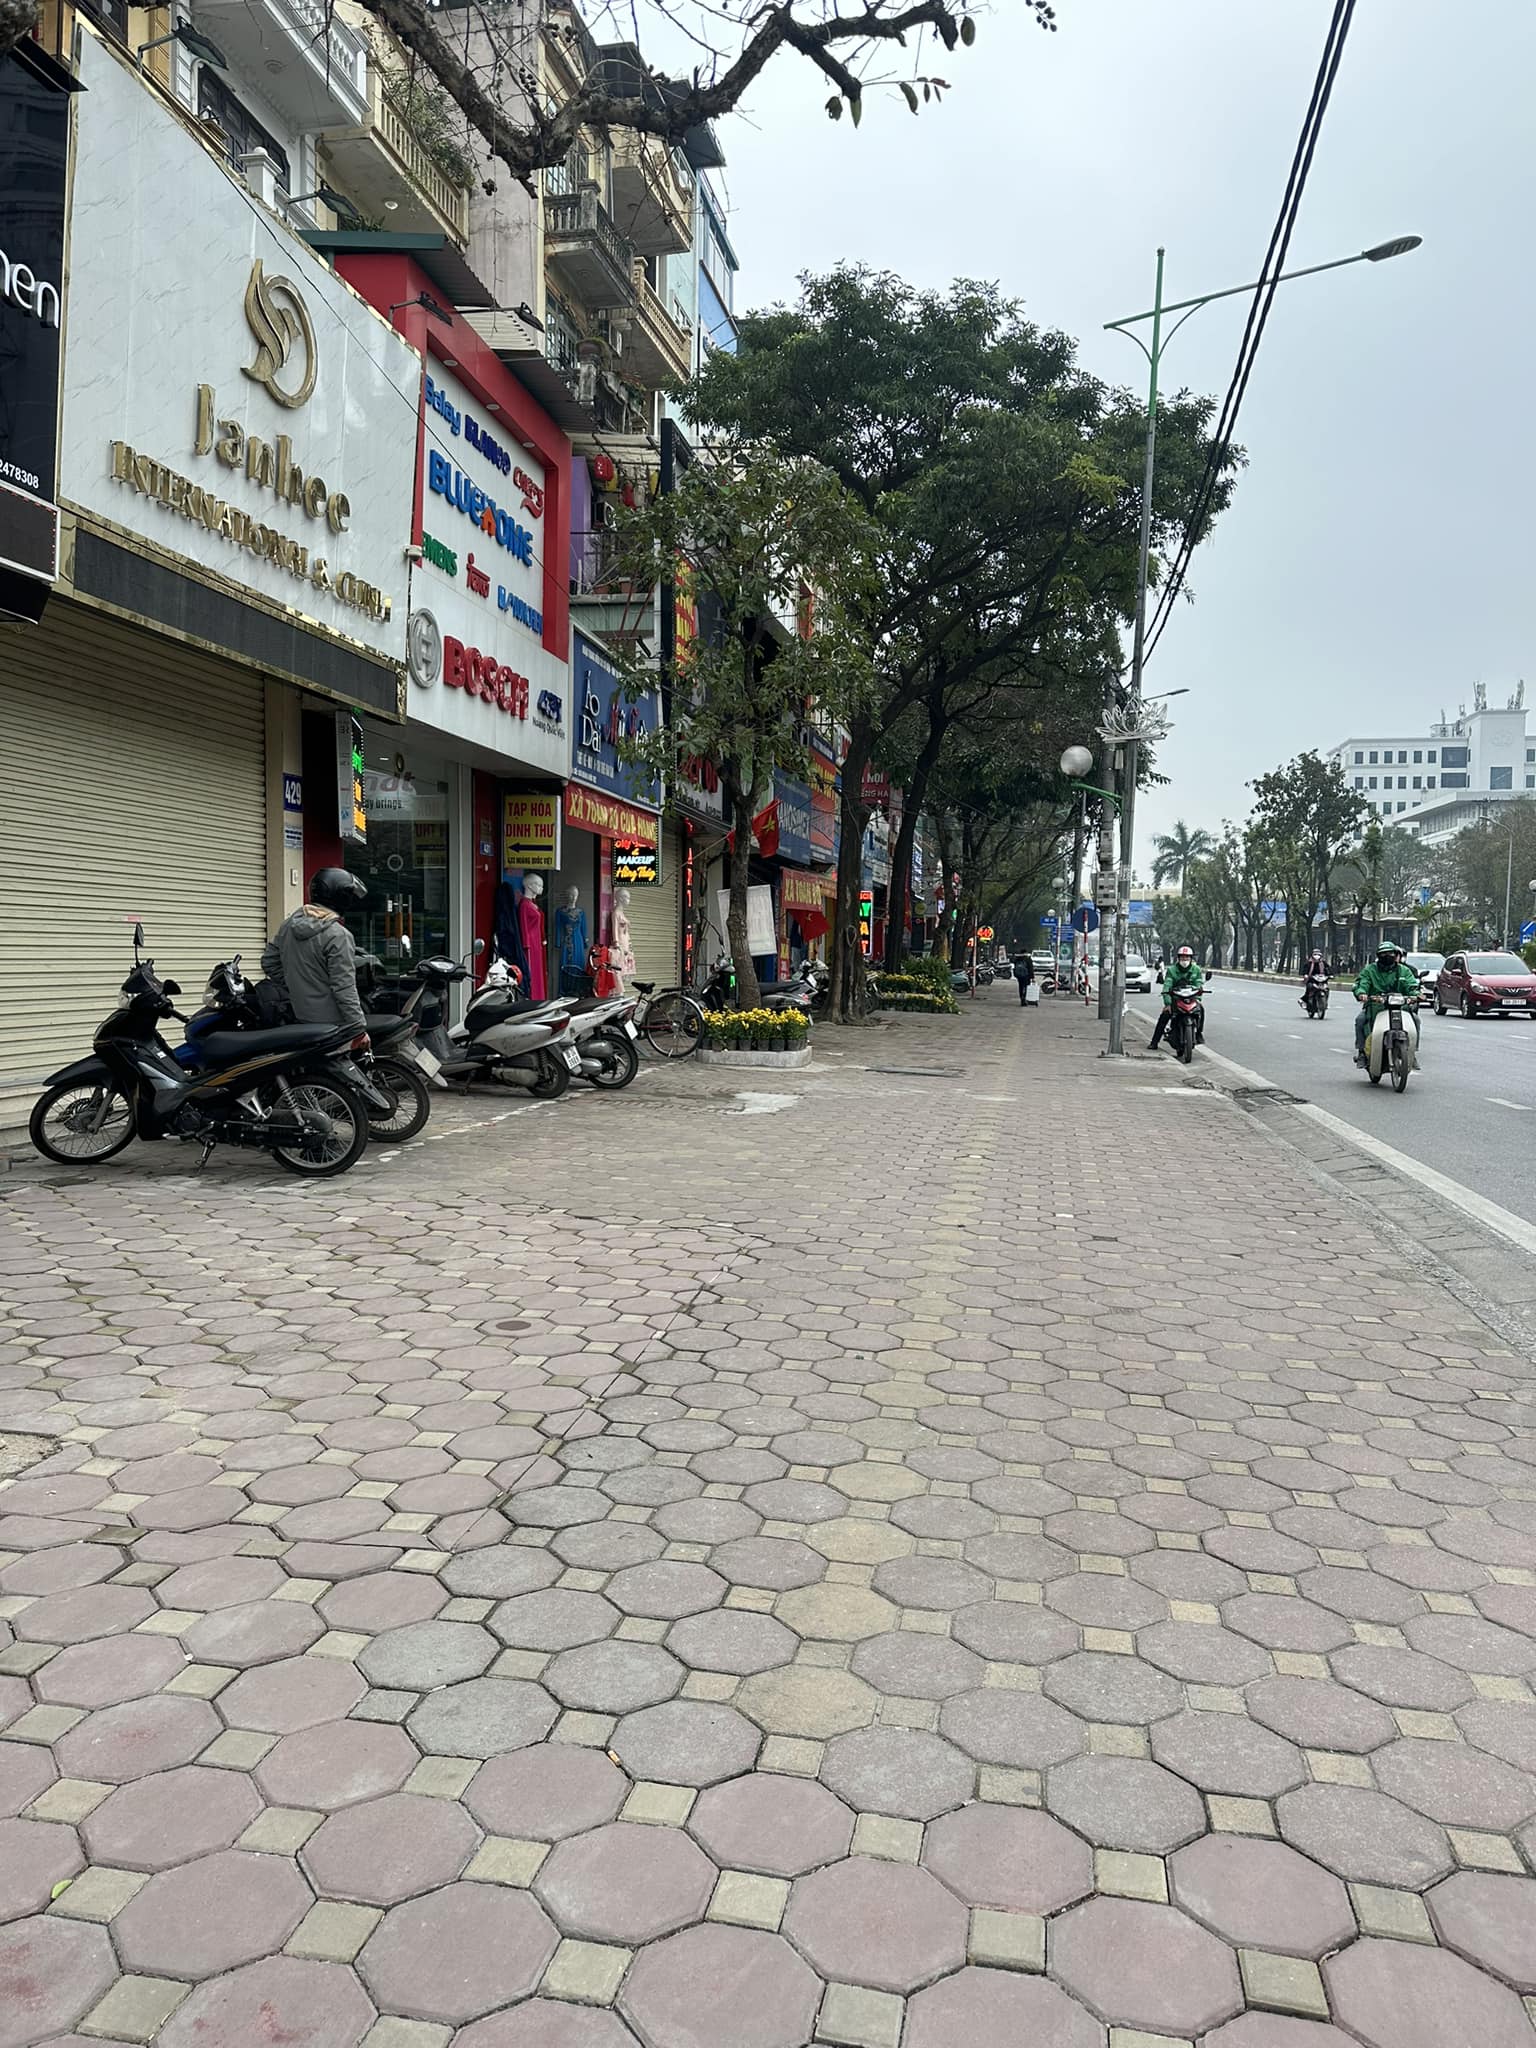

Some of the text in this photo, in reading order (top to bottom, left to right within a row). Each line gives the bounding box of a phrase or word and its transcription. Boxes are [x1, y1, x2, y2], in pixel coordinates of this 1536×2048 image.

[313, 557, 333, 591] &
[443, 636, 529, 721] BOSCH
[285, 780, 302, 806] 429
[508, 800, 552, 819] TẠP HÓA
[616, 855, 656, 865] MAKEUP
